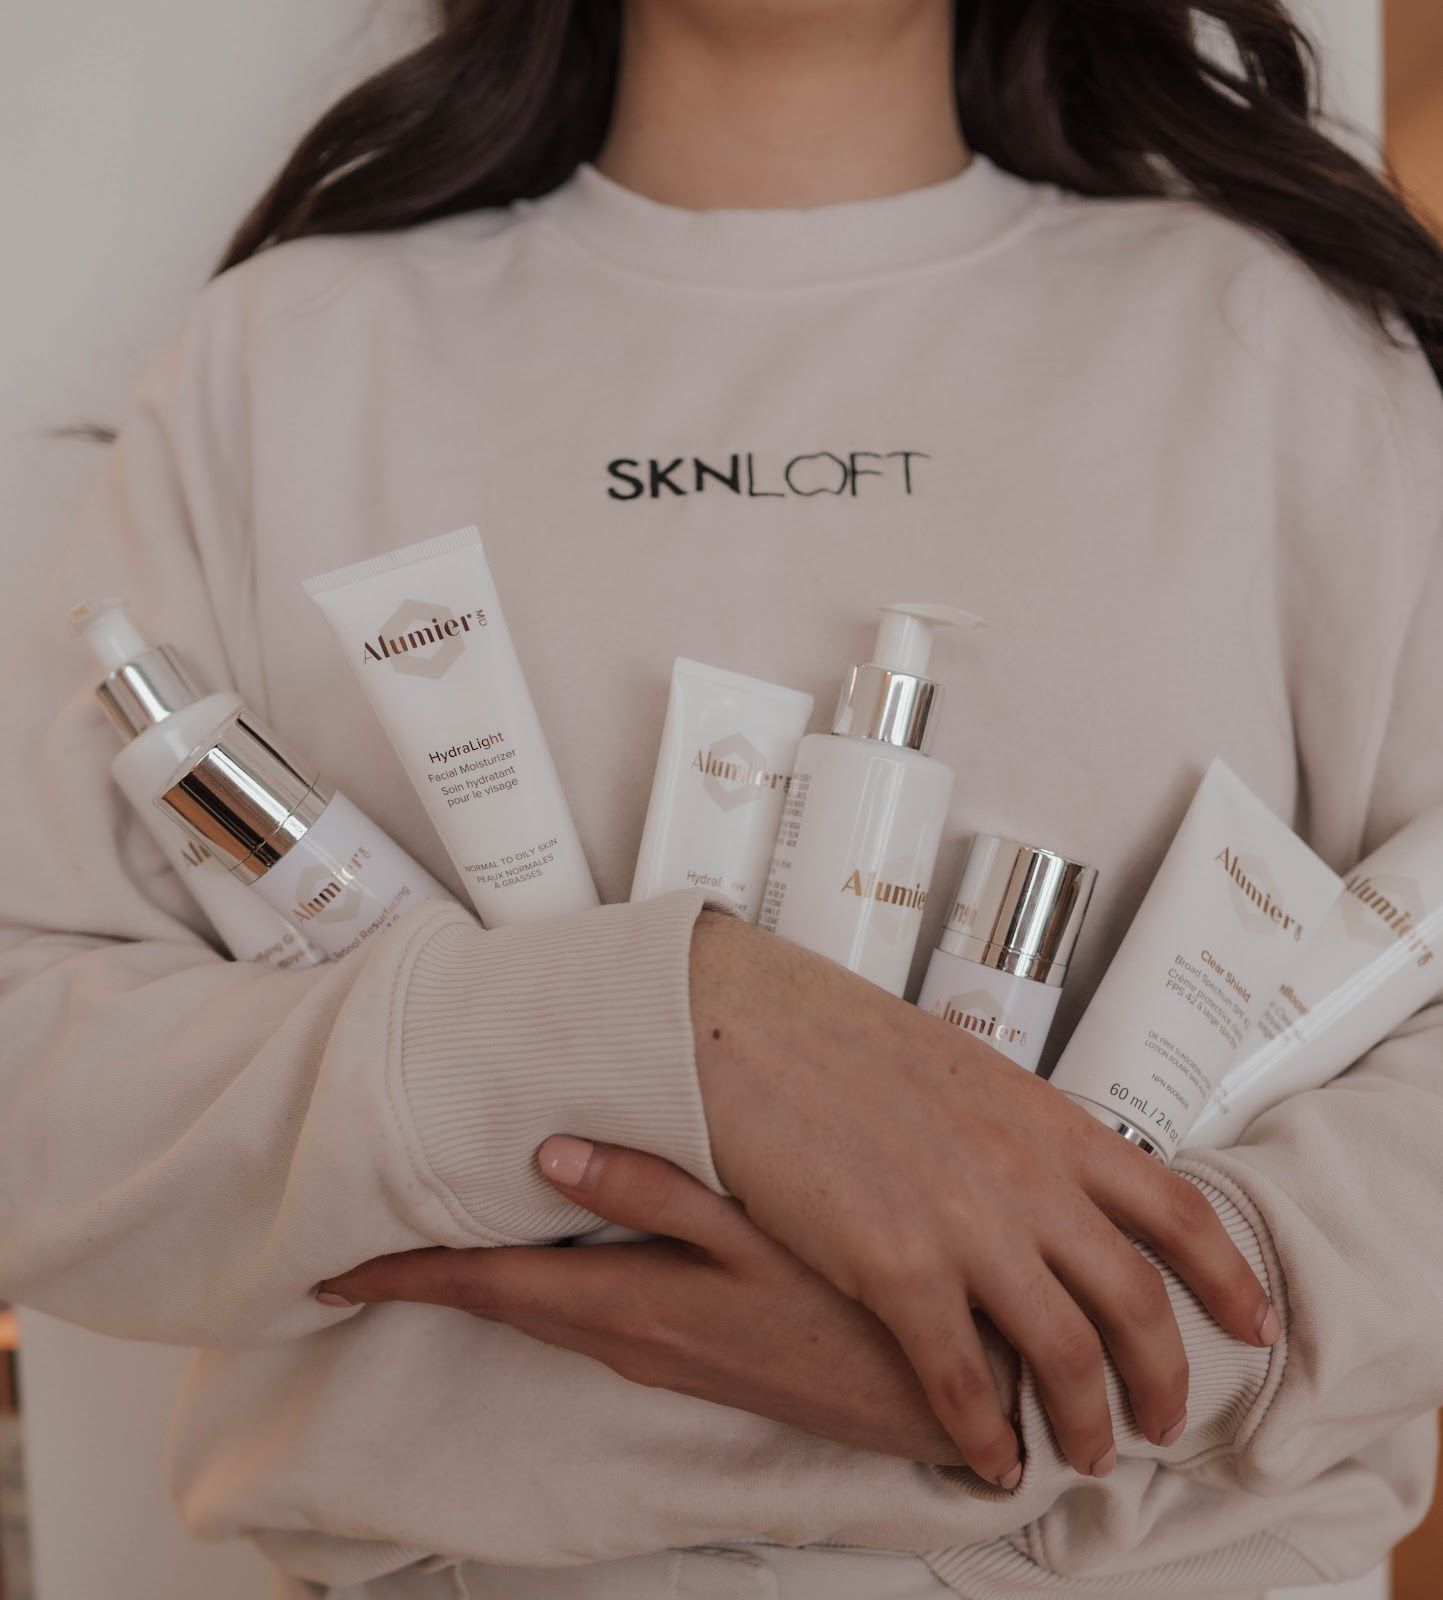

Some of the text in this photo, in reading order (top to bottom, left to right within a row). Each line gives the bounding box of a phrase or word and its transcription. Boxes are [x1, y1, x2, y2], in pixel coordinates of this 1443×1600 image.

[363, 613, 473, 665] Alumier
[429, 732, 505, 764] HydraLight
[428, 749, 516, 783] Facial Moisturizer
[441, 766, 516, 796] Soin hydratant
[690, 749, 783, 790] Alumer
[447, 778, 519, 808] pour le visage
[464, 838, 557, 873] NORMAL TO OILY SKIN
[476, 853, 555, 883] PEAUX NORMALES
[502, 868, 543, 887] GRASSES
[686, 869, 747, 892] Hydraw
[1214, 846, 1296, 931] Alumier
[358, 885, 411, 941] Resurfacing
[1166, 978, 1185, 997] FPS
[1185, 992, 1197, 1007] 42
[1174, 954, 1202, 978] Broad
[1200, 973, 1233, 1008] Spectrum
[1200, 949, 1226, 977] Clear
[1225, 971, 1252, 1003] Shield
[1144, 1039, 1170, 1060] LOTION
[1151, 1072, 1167, 1088] NPN
[1109, 1082, 1130, 1101] 60
[1129, 1095, 1149, 1116] mL
[1155, 1111, 1167, 1127] 2
[1163, 1119, 1173, 1134] fl
